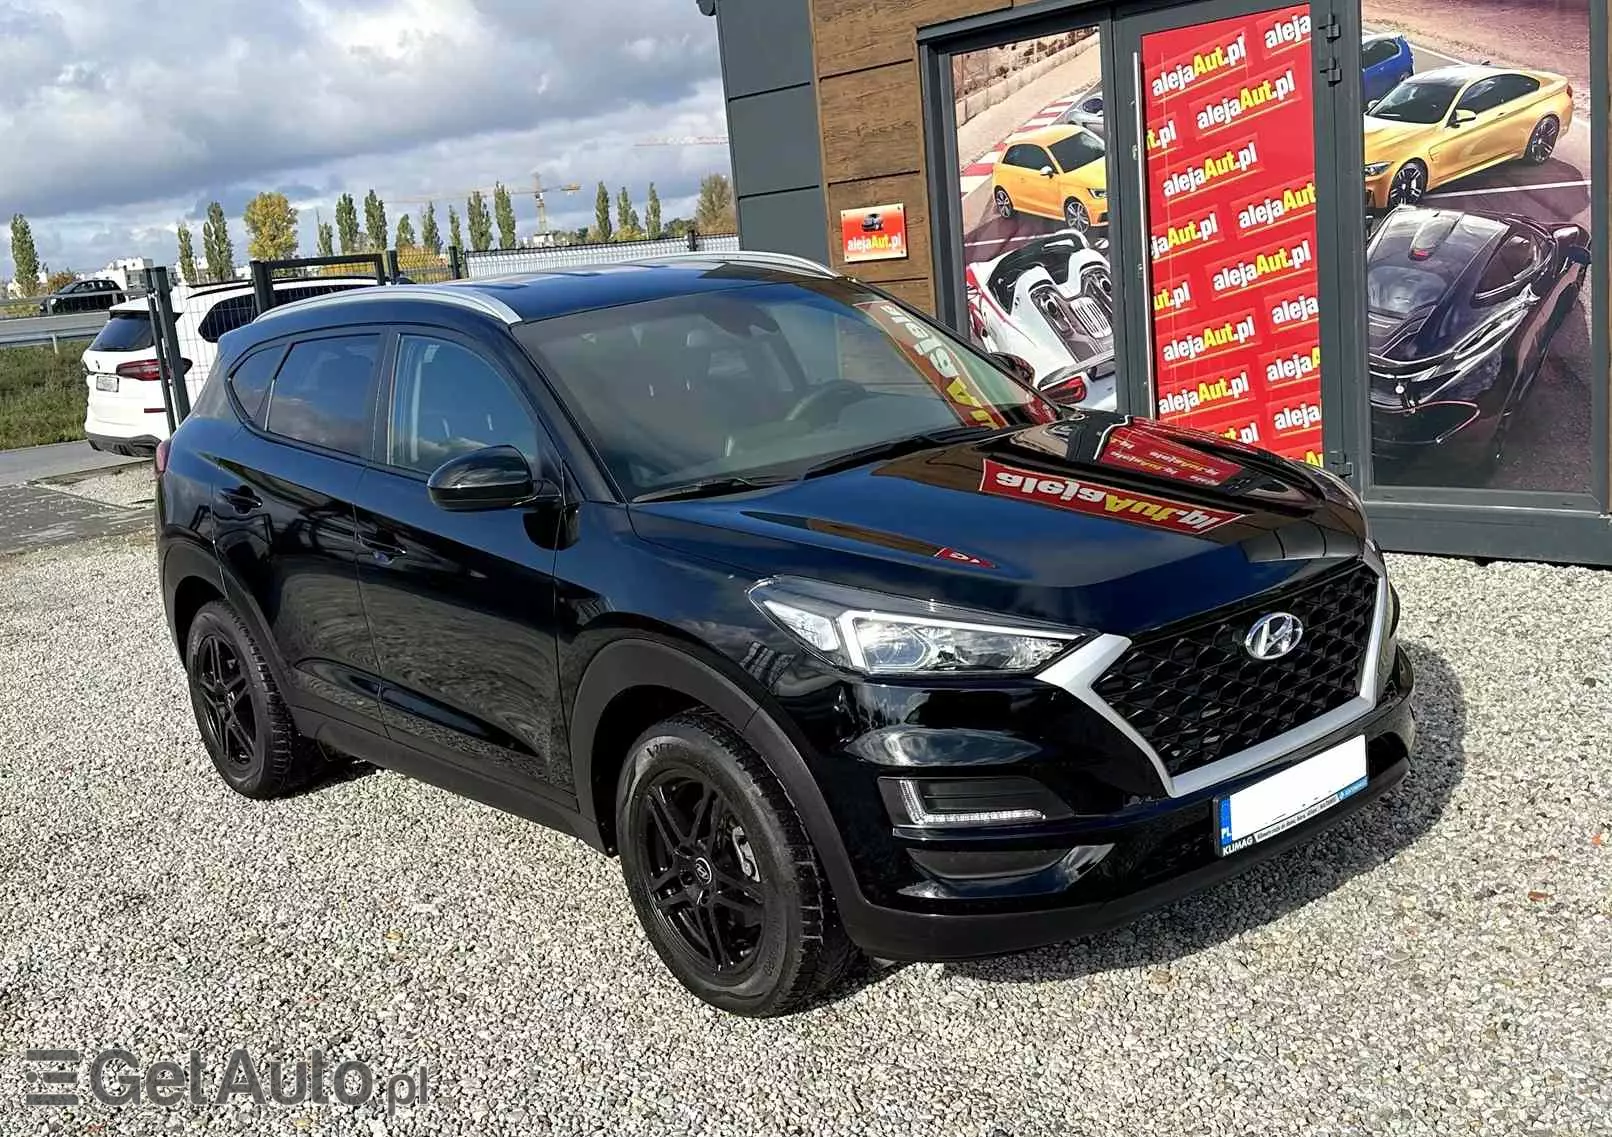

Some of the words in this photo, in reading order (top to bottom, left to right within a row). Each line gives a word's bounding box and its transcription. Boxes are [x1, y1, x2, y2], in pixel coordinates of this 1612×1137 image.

[1151, 31, 1246, 96] alejaAut.pl
[1196, 70, 1296, 130] alejaAut.pl
[1146, 120, 1177, 149] t.pl
[1163, 141, 1258, 197] alejaAut.pl
[1238, 182, 1316, 229] alejaAut
[847, 232, 902, 253] alejaAut.pl
[1151, 213, 1218, 259] jaAut.pl
[1212, 240, 1311, 291] alejaAut.pl
[1162, 316, 1255, 361] alejaAut.pl
[1158, 372, 1249, 414] alejaAut.pl
[1221, 827, 1232, 840] PL
[1222, 835, 1253, 857] KLIMAG
